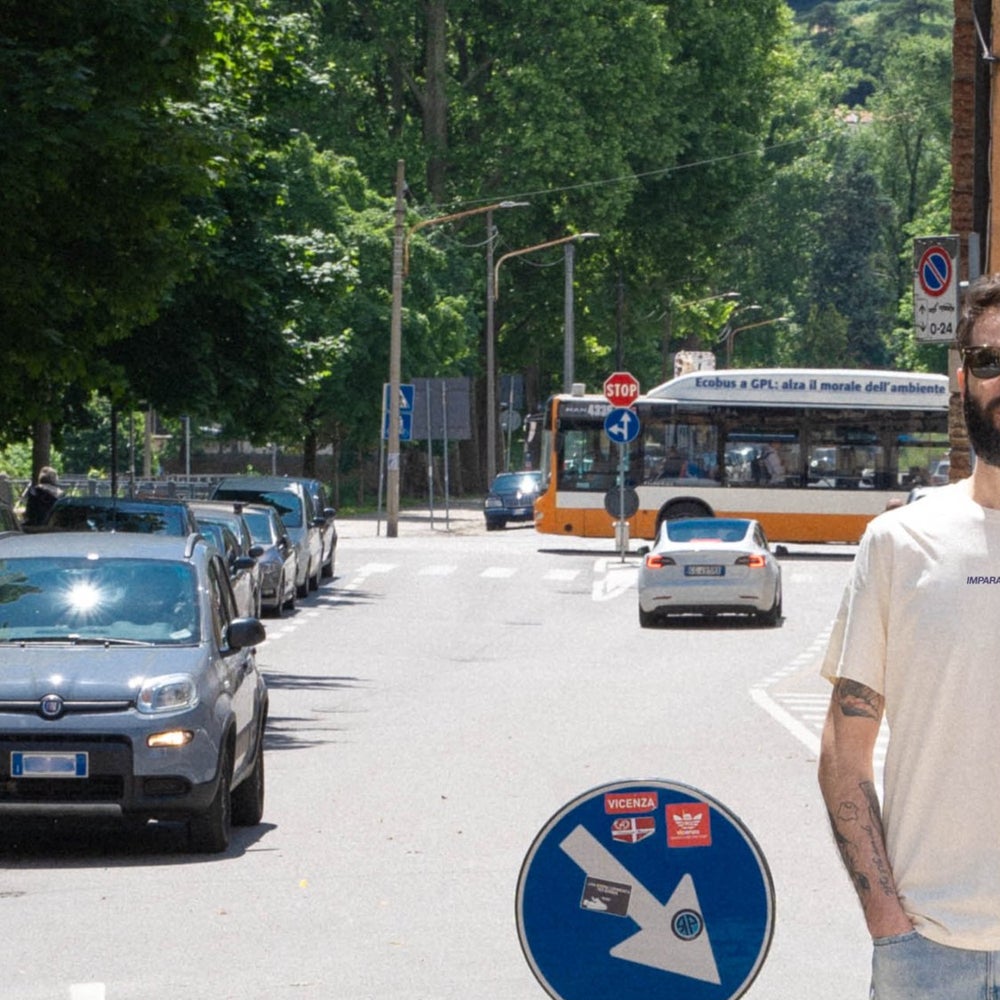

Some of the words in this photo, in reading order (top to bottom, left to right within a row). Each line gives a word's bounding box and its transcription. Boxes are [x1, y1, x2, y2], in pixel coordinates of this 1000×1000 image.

[930, 322, 952, 335] 0-24
[606, 384, 637, 397] STOP
[695, 377, 736, 388] Ecobus
[740, 380, 747, 389] a
[751, 379, 778, 390] GPL:
[782, 379, 806, 390] alza
[809, 379, 817, 390] il
[821, 381, 862, 392] morale
[865, 381, 946, 393] dell'ambiente
[608, 798, 655, 809] VICENZA
